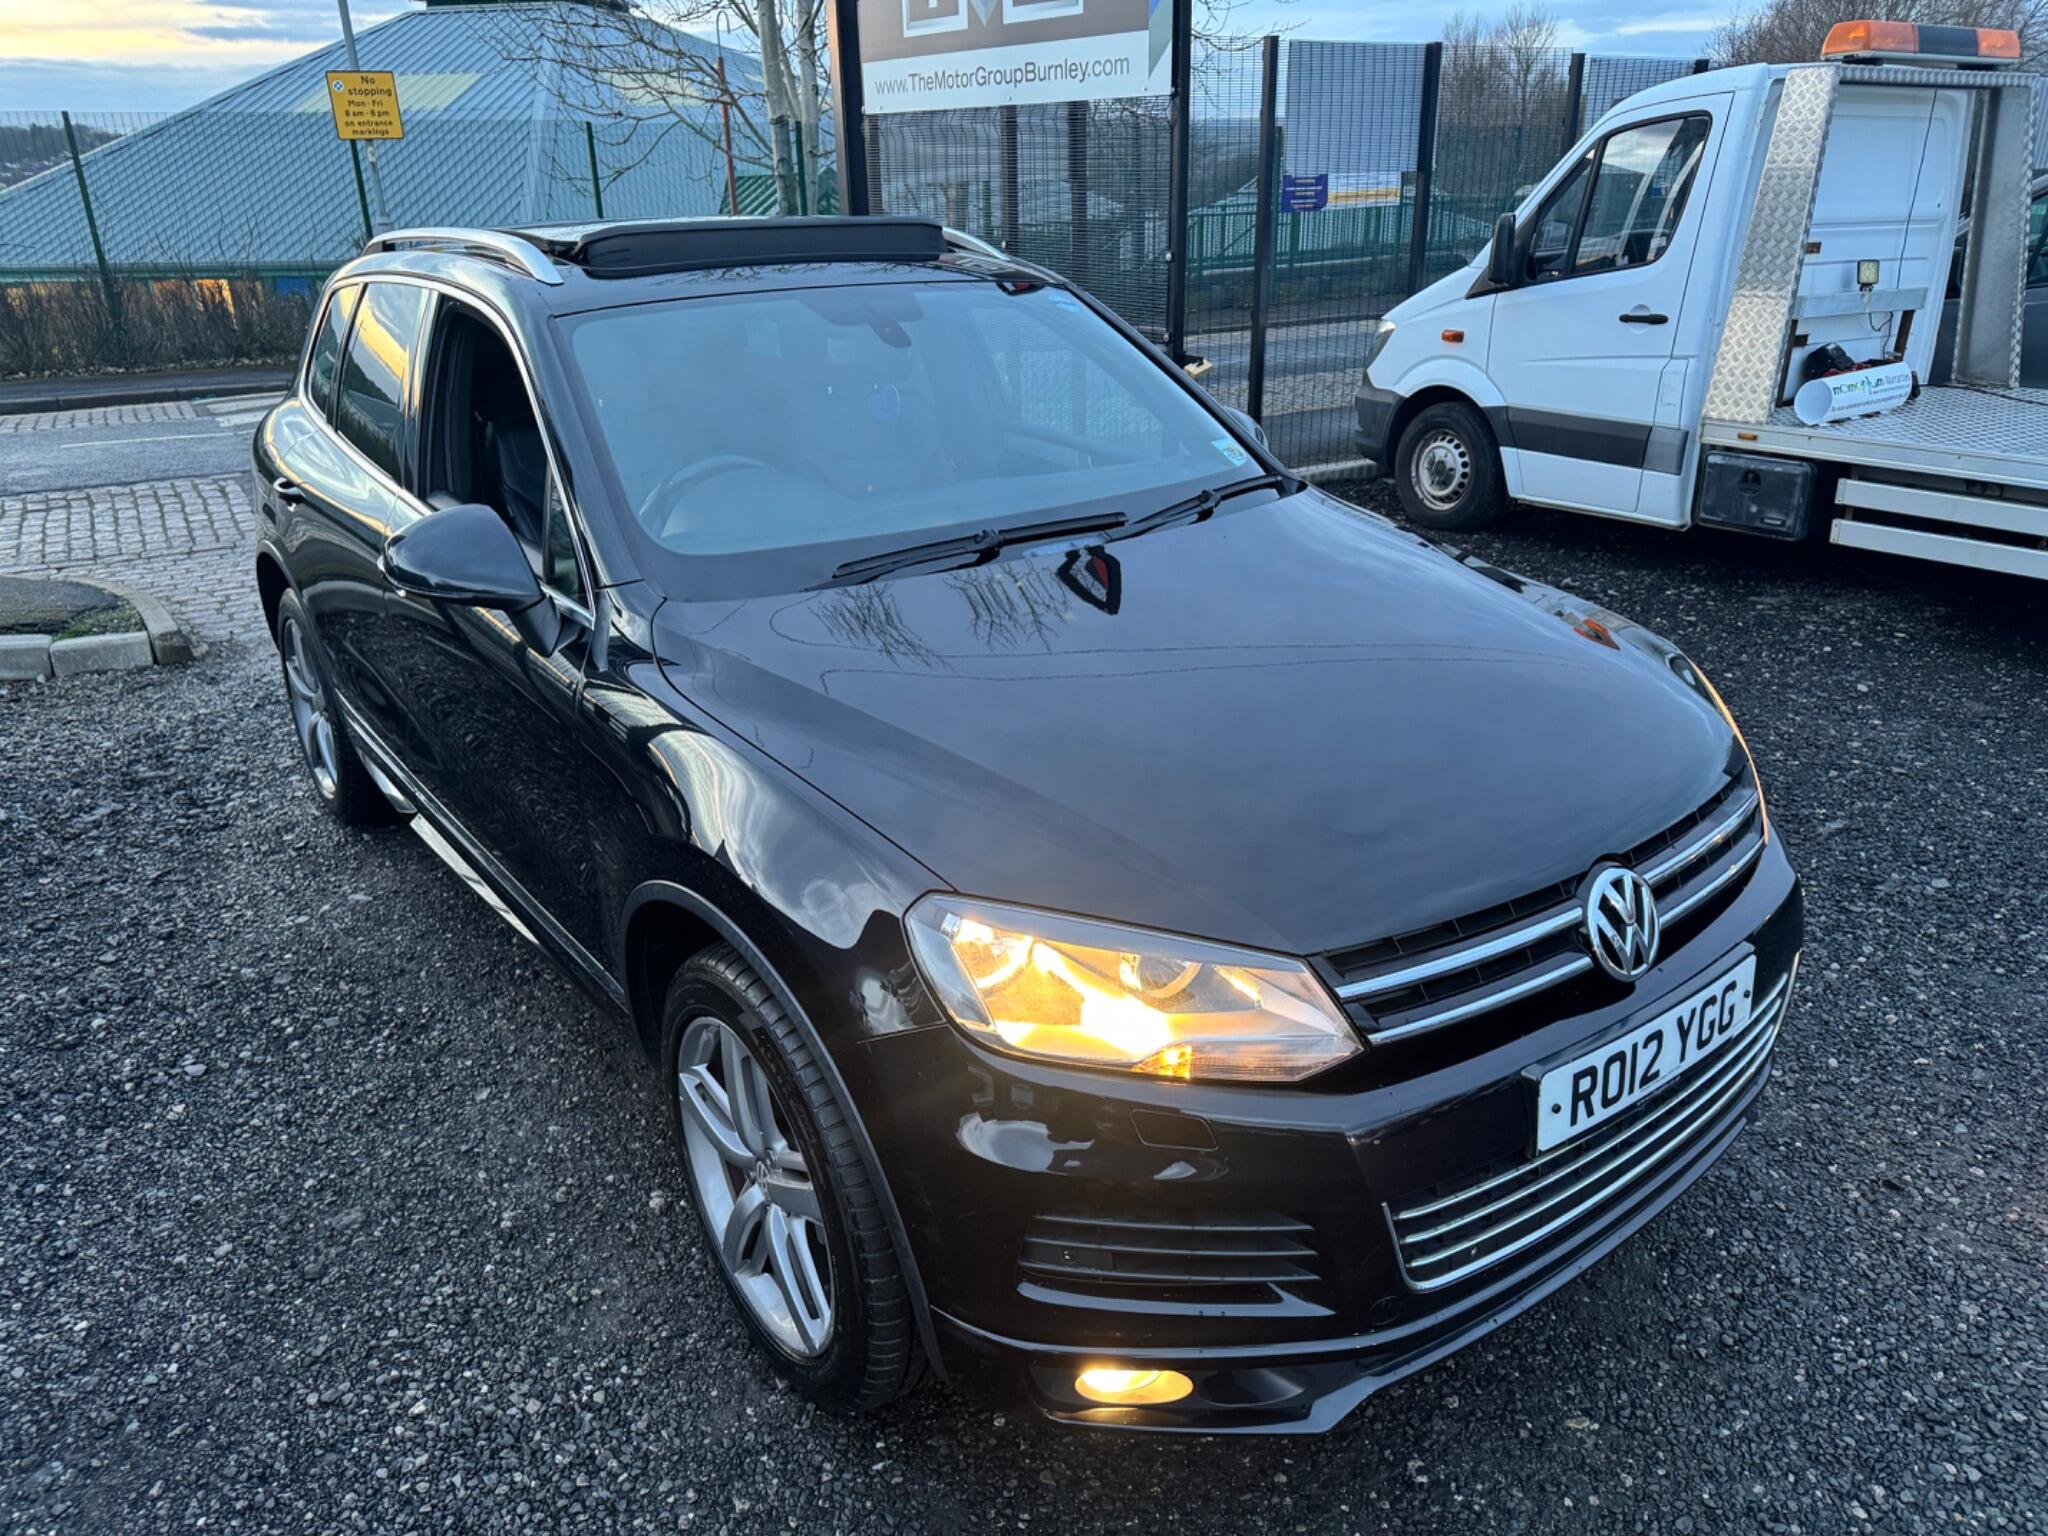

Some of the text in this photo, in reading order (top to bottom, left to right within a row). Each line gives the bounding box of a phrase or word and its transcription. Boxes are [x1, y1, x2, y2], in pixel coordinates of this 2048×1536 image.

[360, 75, 376, 85] No
[875, 57, 1130, 95] www.TheMotorGroupBurnley.com
[348, 87, 392, 97] stopping
[357, 119, 393, 127] entrance
[352, 128, 390, 136] markings
[1570, 980, 1738, 1127] RO12 YGG
